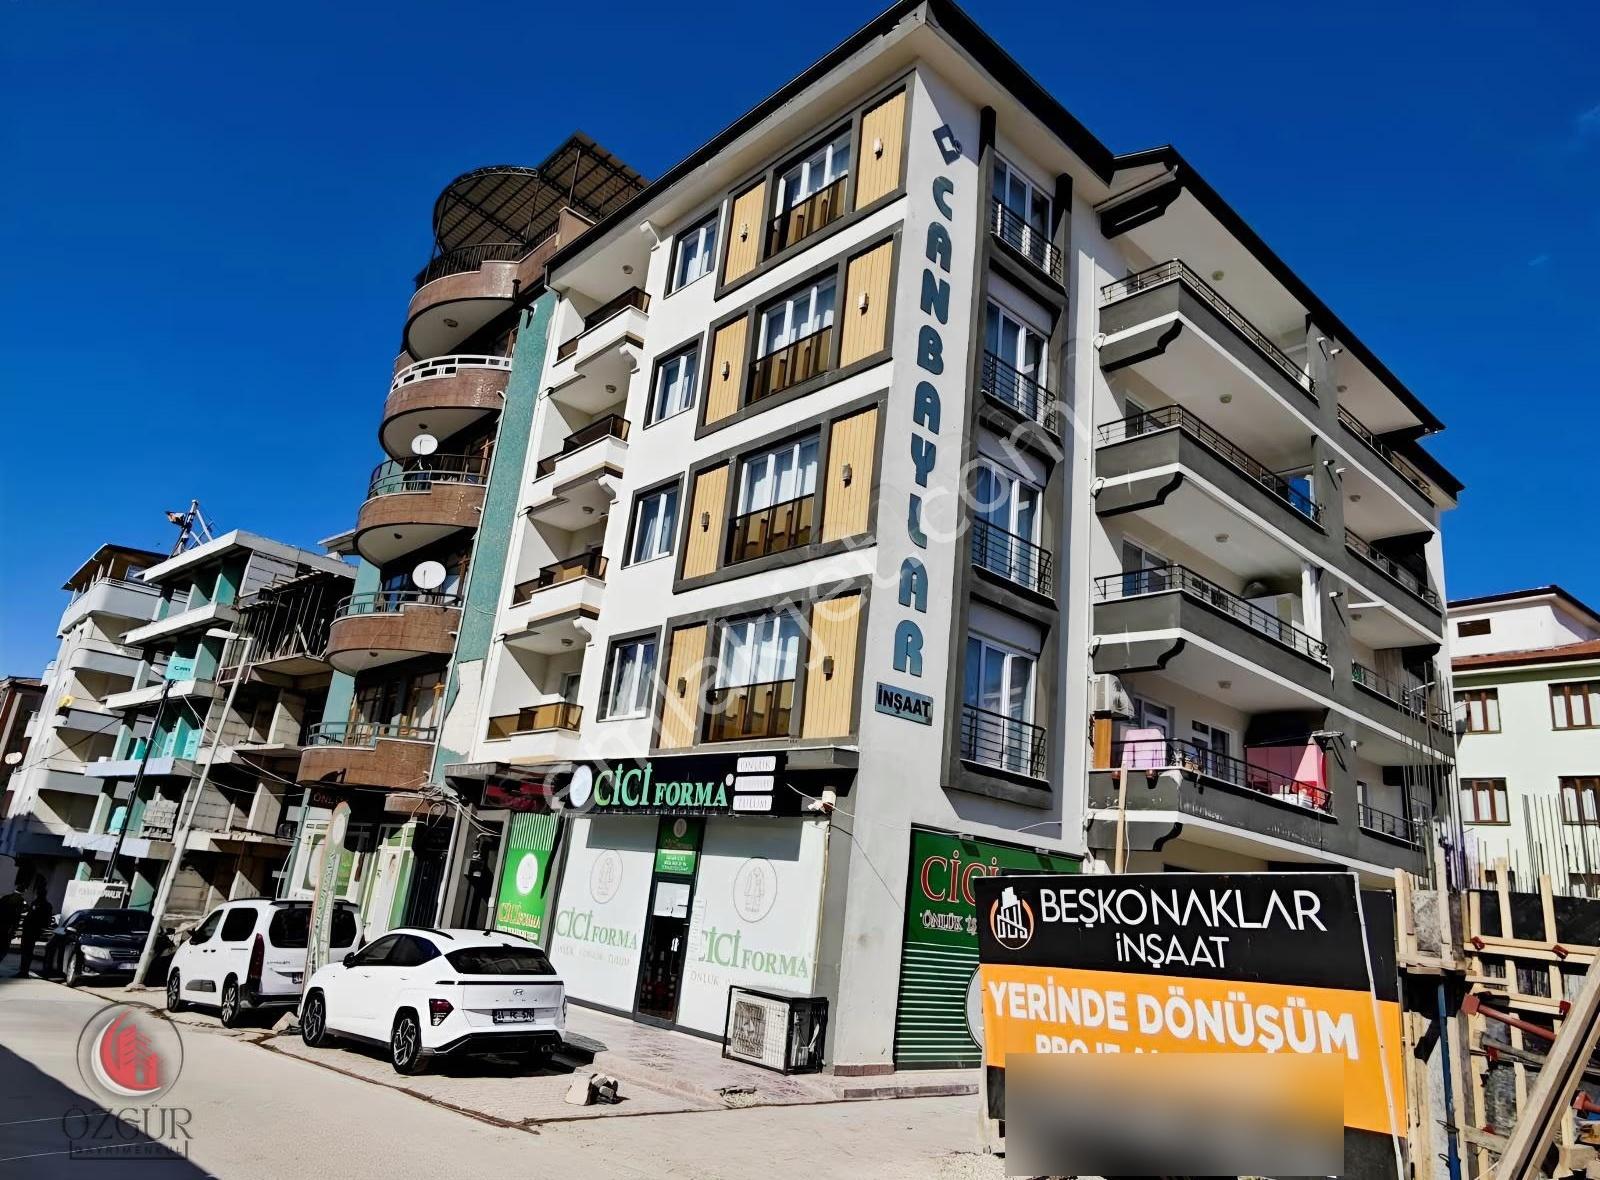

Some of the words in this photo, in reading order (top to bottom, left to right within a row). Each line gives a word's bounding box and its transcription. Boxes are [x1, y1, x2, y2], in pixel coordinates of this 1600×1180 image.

[892, 175, 955, 678] CANBAYLAR
[876, 684, 931, 718] İNŞAAT
[594, 762, 653, 807] CİCİ
[652, 781, 728, 807] FORMA
[555, 907, 593, 942] CİCİ
[591, 925, 638, 950] FORMA
[1040, 889, 1328, 931] BEŞKONAKLAR
[740, 948, 809, 979] FORMA
[1116, 932, 1230, 968] İNŞAAT
[988, 976, 1129, 1032] YERİNDE
[1137, 985, 1360, 1060] DÖNÜŞÜM
